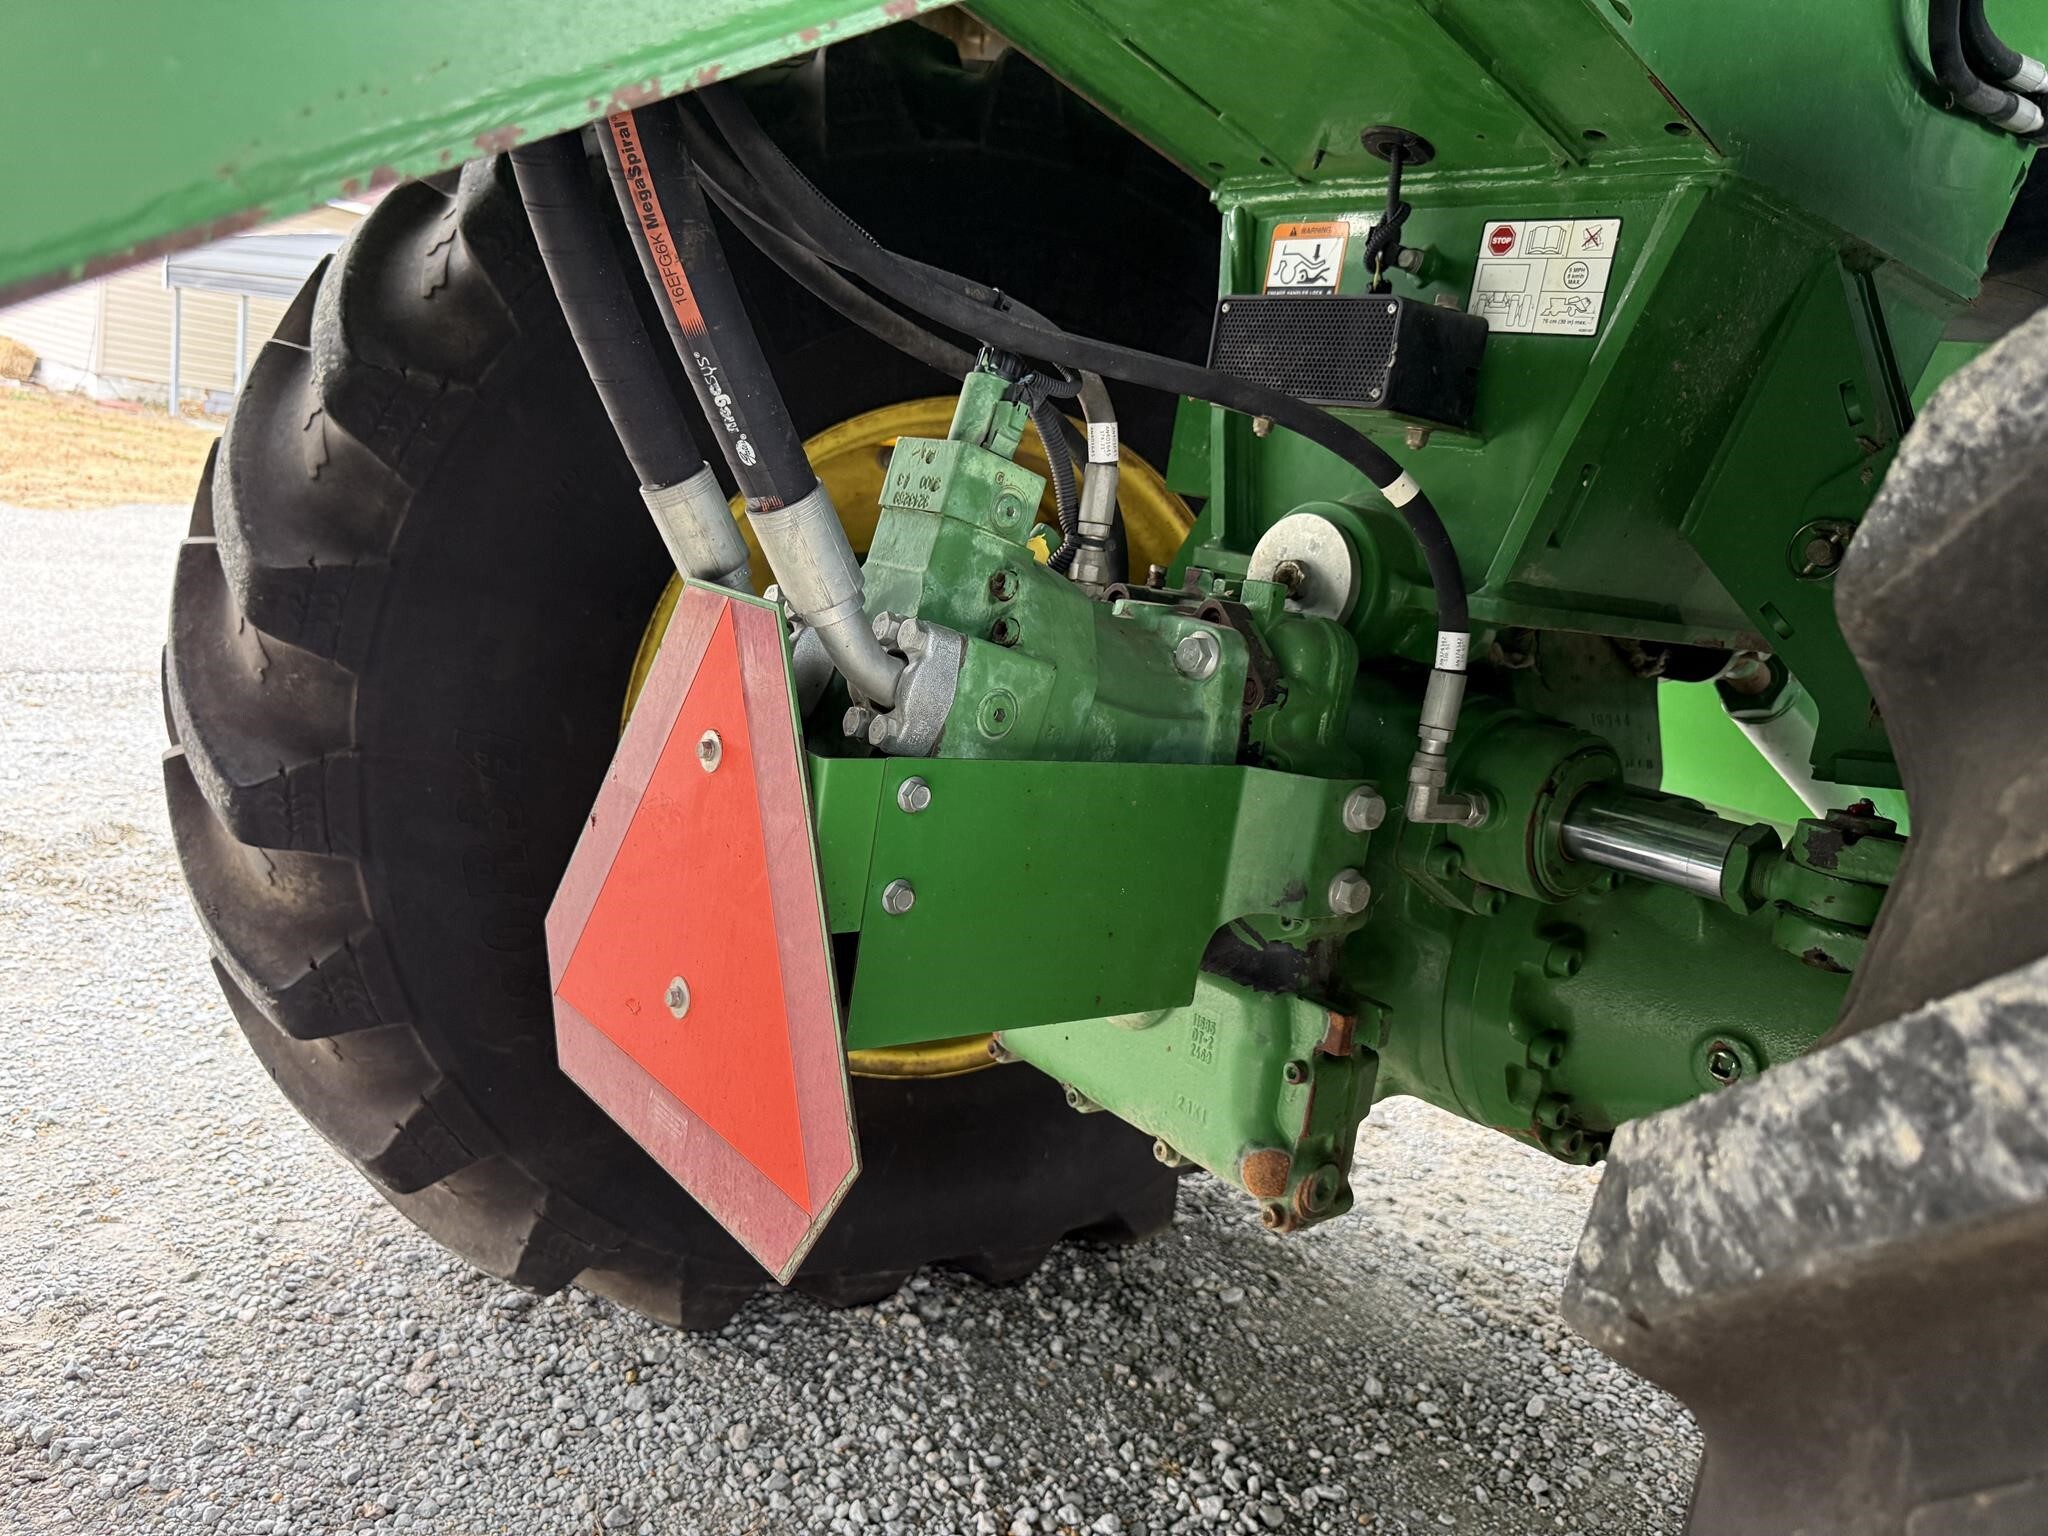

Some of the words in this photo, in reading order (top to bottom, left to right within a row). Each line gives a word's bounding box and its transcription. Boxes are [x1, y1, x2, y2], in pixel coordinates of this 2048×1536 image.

[613, 120, 660, 230] MegaSpiral
[1301, 226, 1331, 234] WARNING
[1491, 236, 1512, 245] STOP
[650, 232, 688, 306] 16EFG6K
